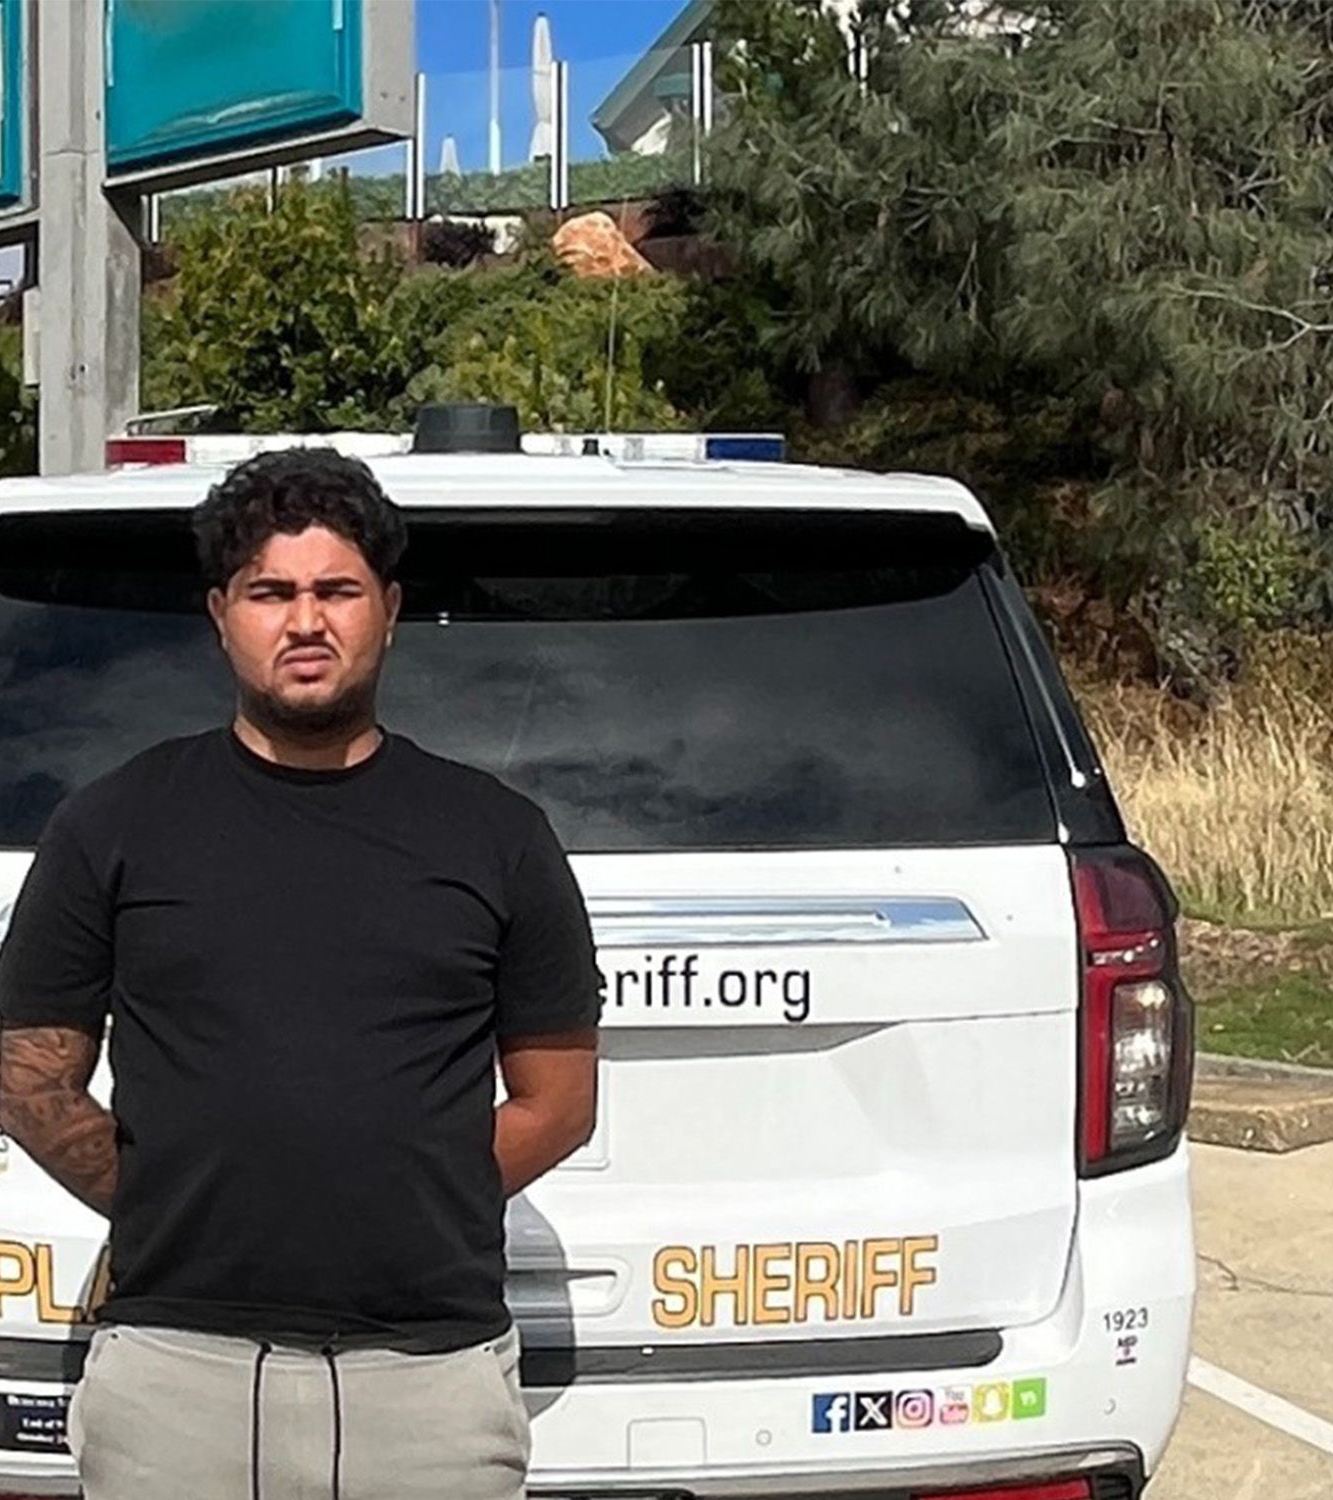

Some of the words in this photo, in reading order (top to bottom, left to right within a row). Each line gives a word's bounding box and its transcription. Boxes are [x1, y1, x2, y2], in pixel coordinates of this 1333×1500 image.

[599, 954, 811, 1023] riff.org
[652, 1235, 938, 1329] SHERIFF
[1103, 1307, 1148, 1332] 1923
